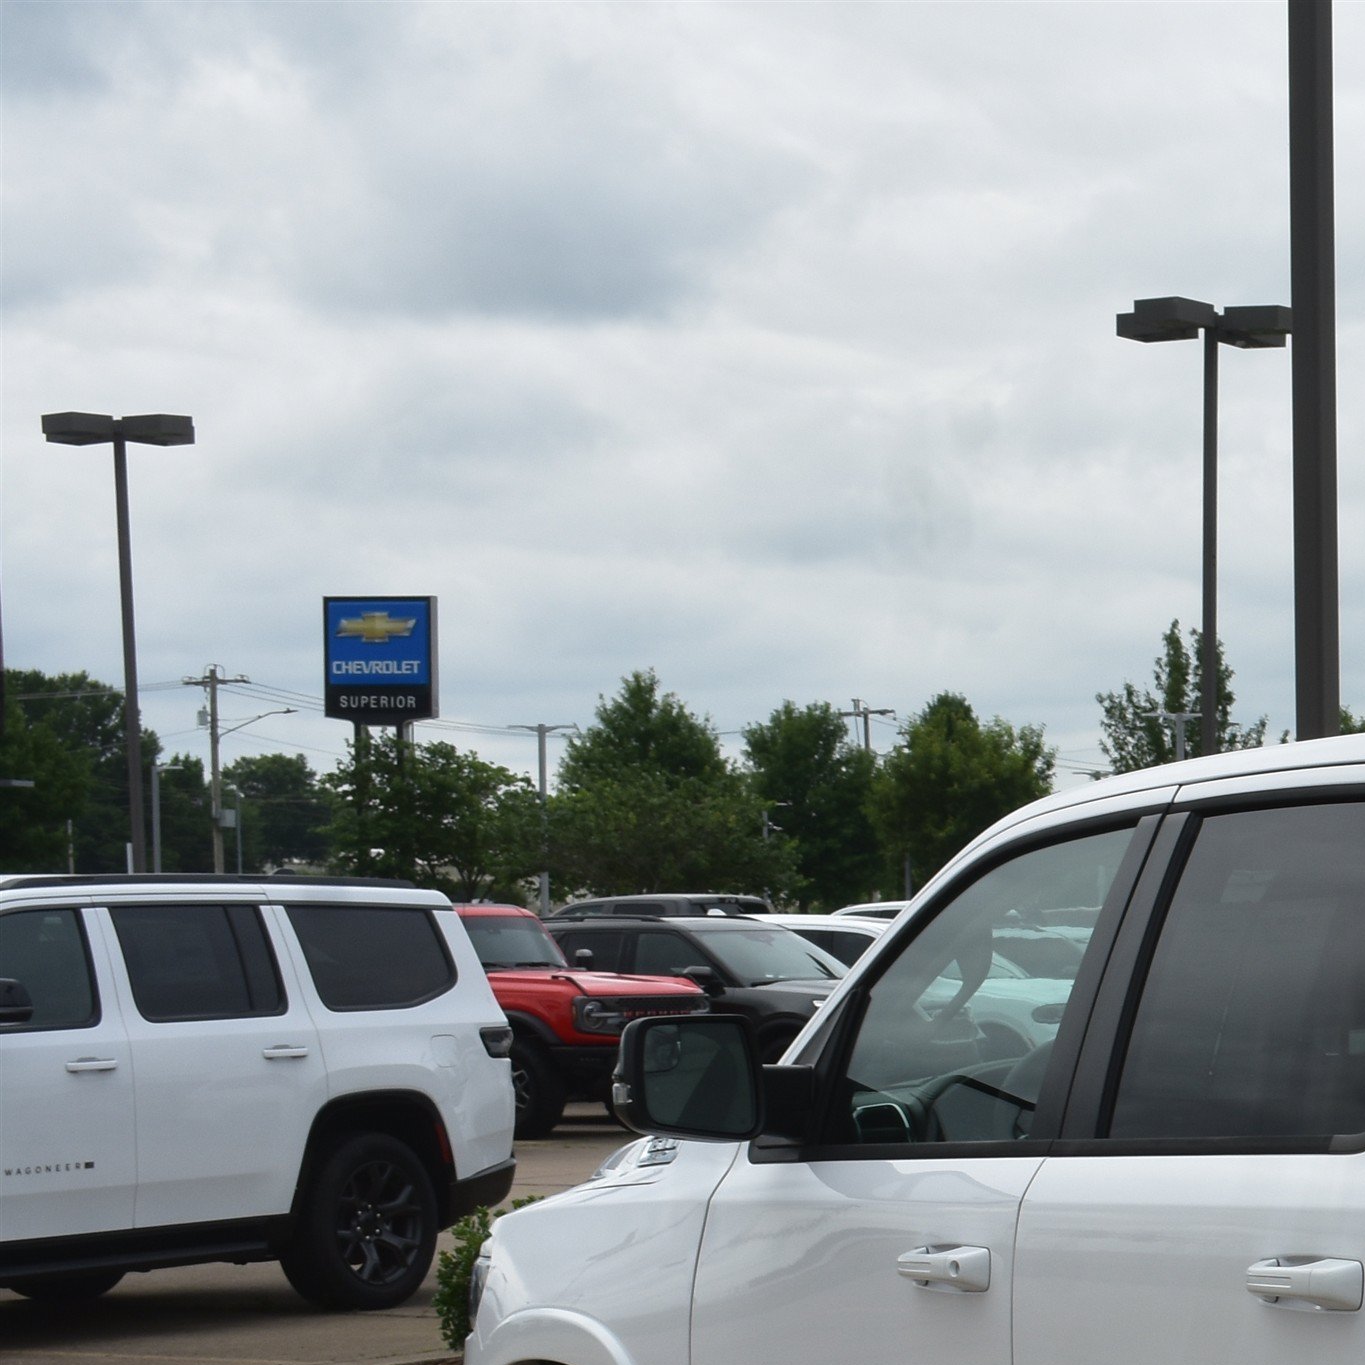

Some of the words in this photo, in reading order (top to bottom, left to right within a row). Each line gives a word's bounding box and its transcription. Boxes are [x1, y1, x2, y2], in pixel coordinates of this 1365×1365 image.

[332, 661, 420, 674] CHEVROLET
[340, 695, 416, 708] SUPERIOR
[4, 1162, 81, 1176] WAGONEER
